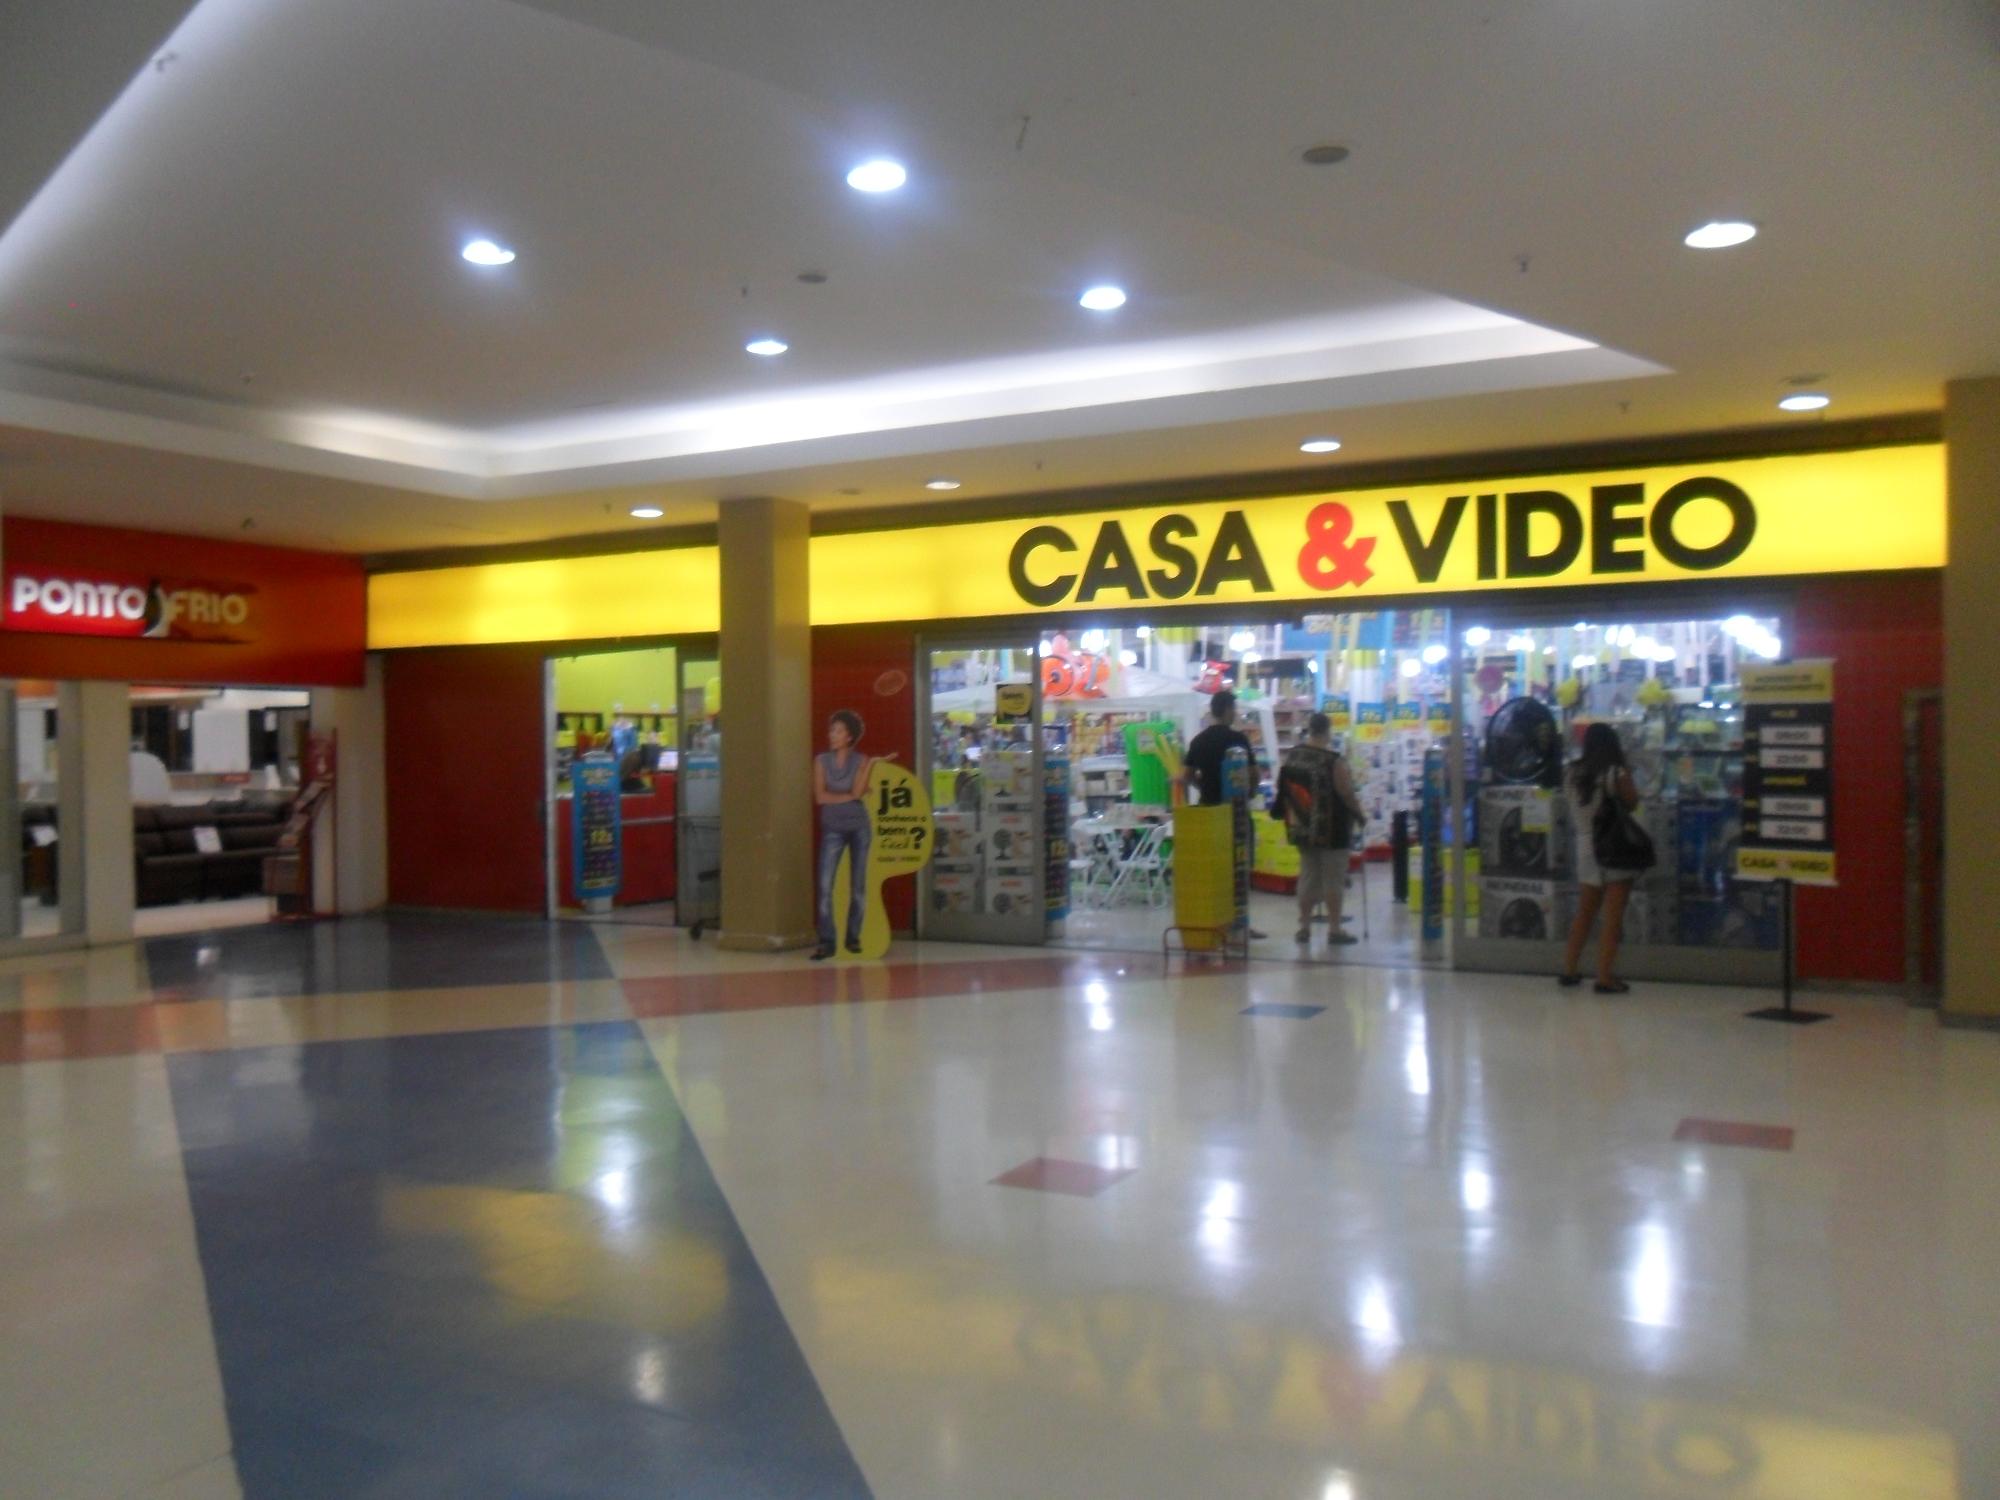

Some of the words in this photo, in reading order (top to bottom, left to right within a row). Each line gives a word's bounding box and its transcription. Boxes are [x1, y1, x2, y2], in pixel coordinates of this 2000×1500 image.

[1009, 513, 1274, 607] CASA
[1297, 501, 1377, 591] &
[1386, 476, 1757, 584] VIDEO
[12, 577, 147, 620] PONTO
[166, 589, 248, 625] FRIO
[877, 778, 912, 816] já
